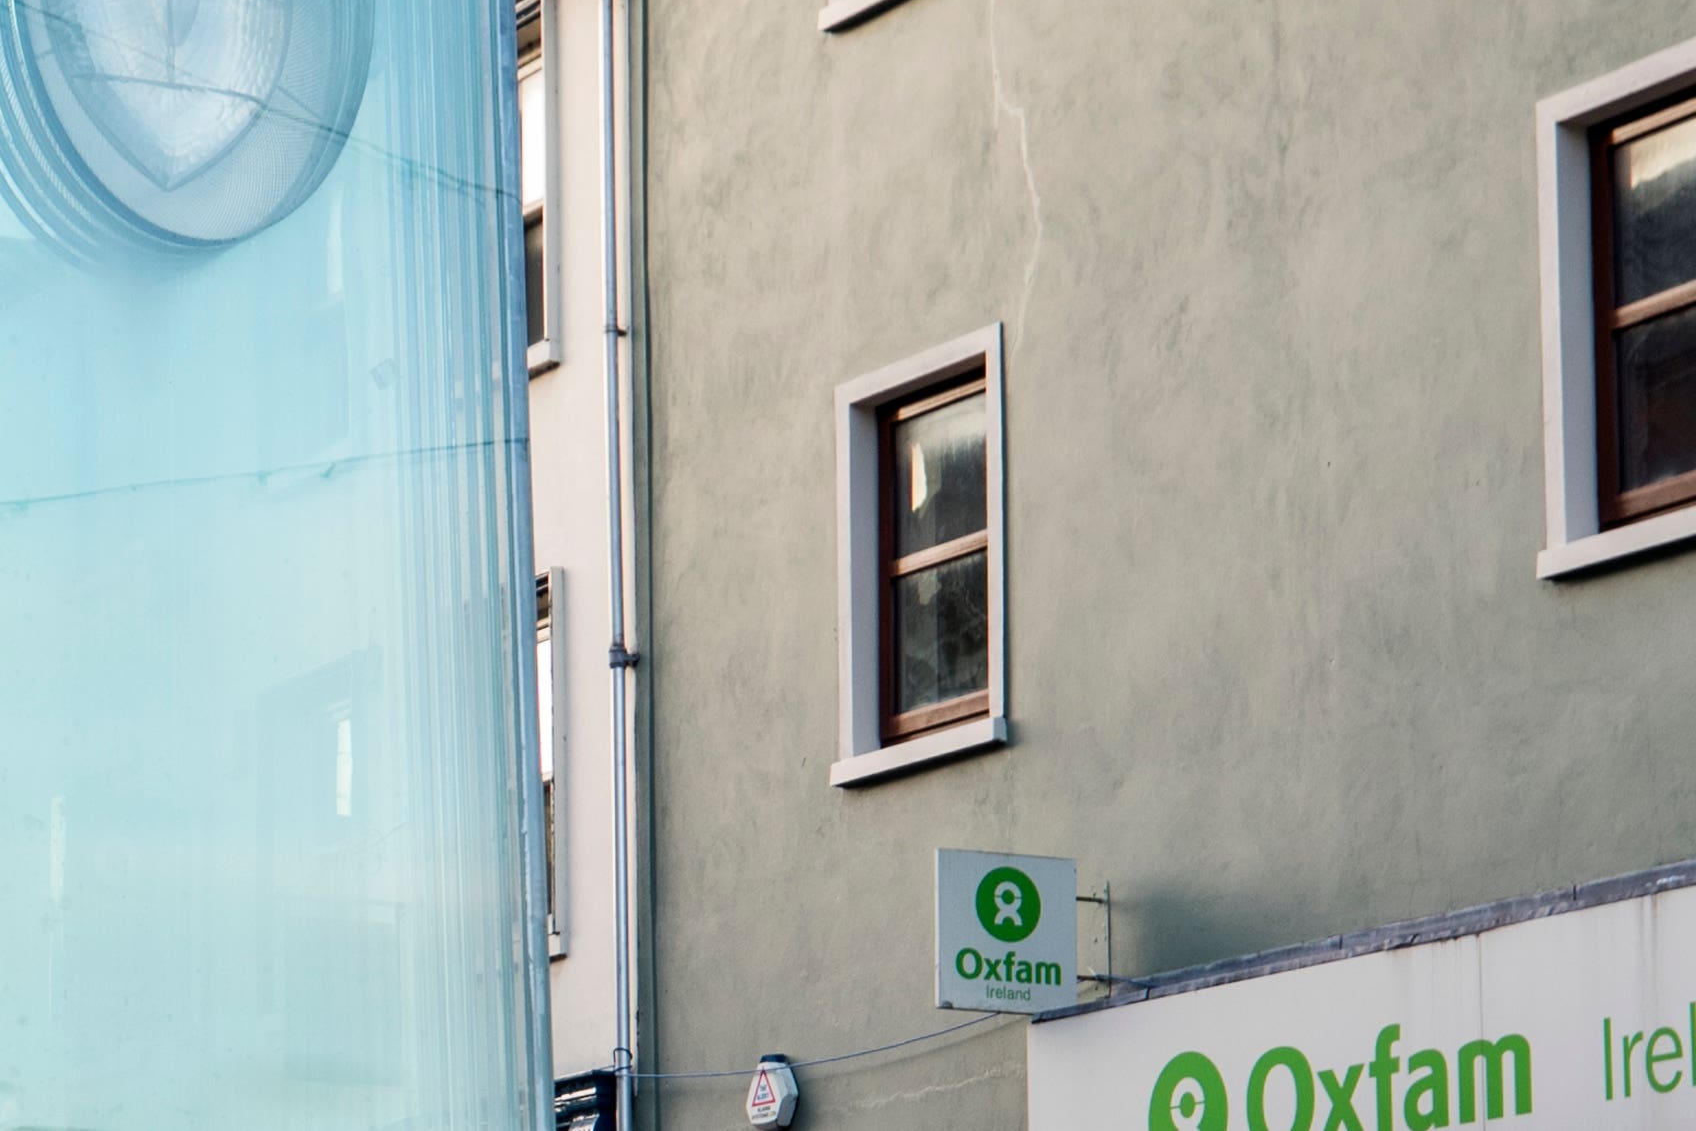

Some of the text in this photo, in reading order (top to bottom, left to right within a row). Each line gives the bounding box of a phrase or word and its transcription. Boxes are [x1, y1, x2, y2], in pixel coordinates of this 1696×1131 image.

[956, 947, 1061, 986] Oxfam
[986, 985, 1031, 1001] Ireland
[1246, 1023, 1533, 1131] Oxfam
